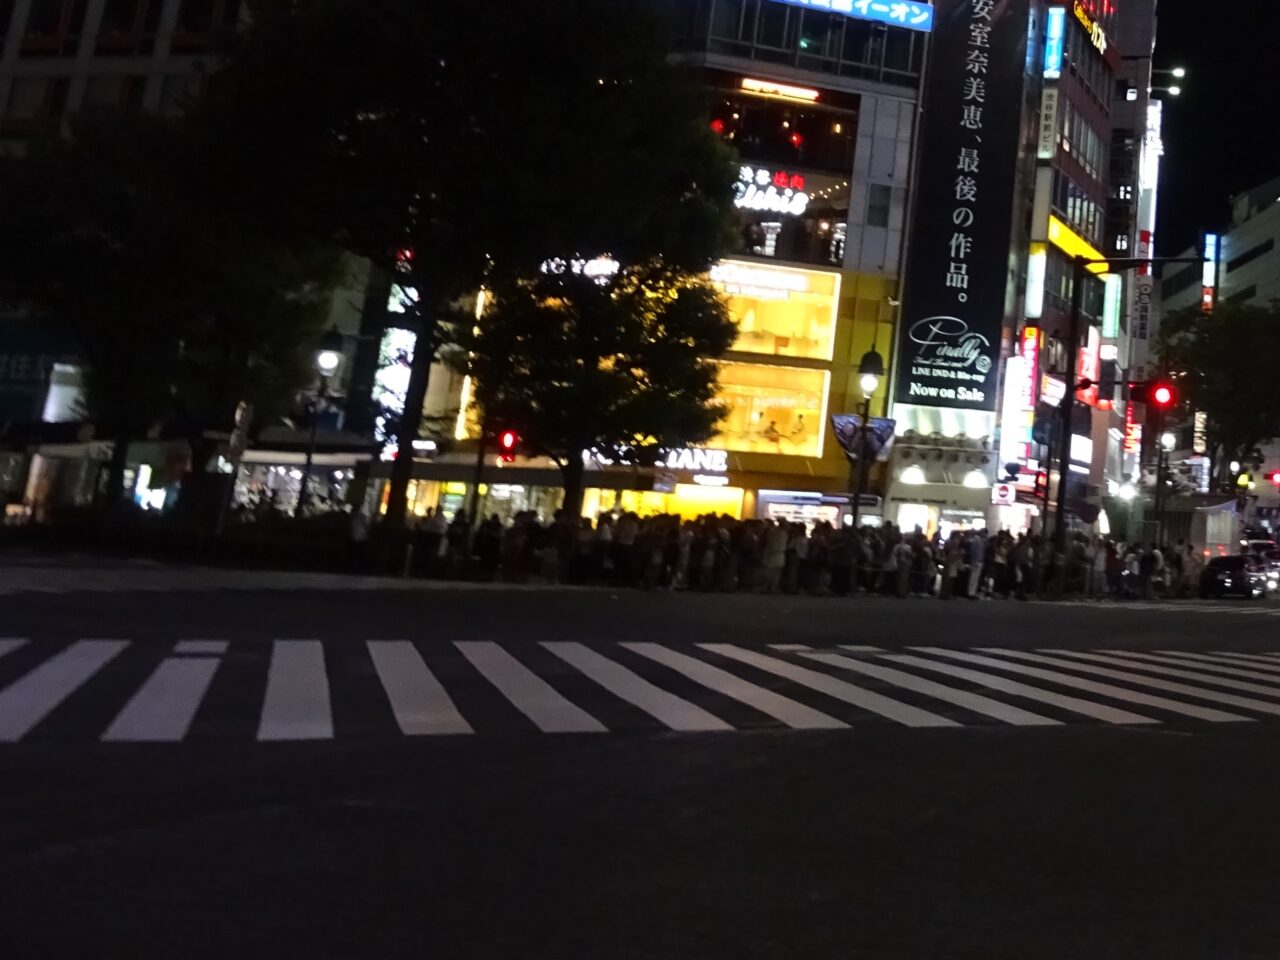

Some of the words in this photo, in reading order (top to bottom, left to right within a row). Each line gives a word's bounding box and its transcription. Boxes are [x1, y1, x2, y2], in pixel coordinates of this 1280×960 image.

[909, 382, 939, 396] Now
[940, 388, 955, 399] on
[957, 386, 985, 402] Sale
